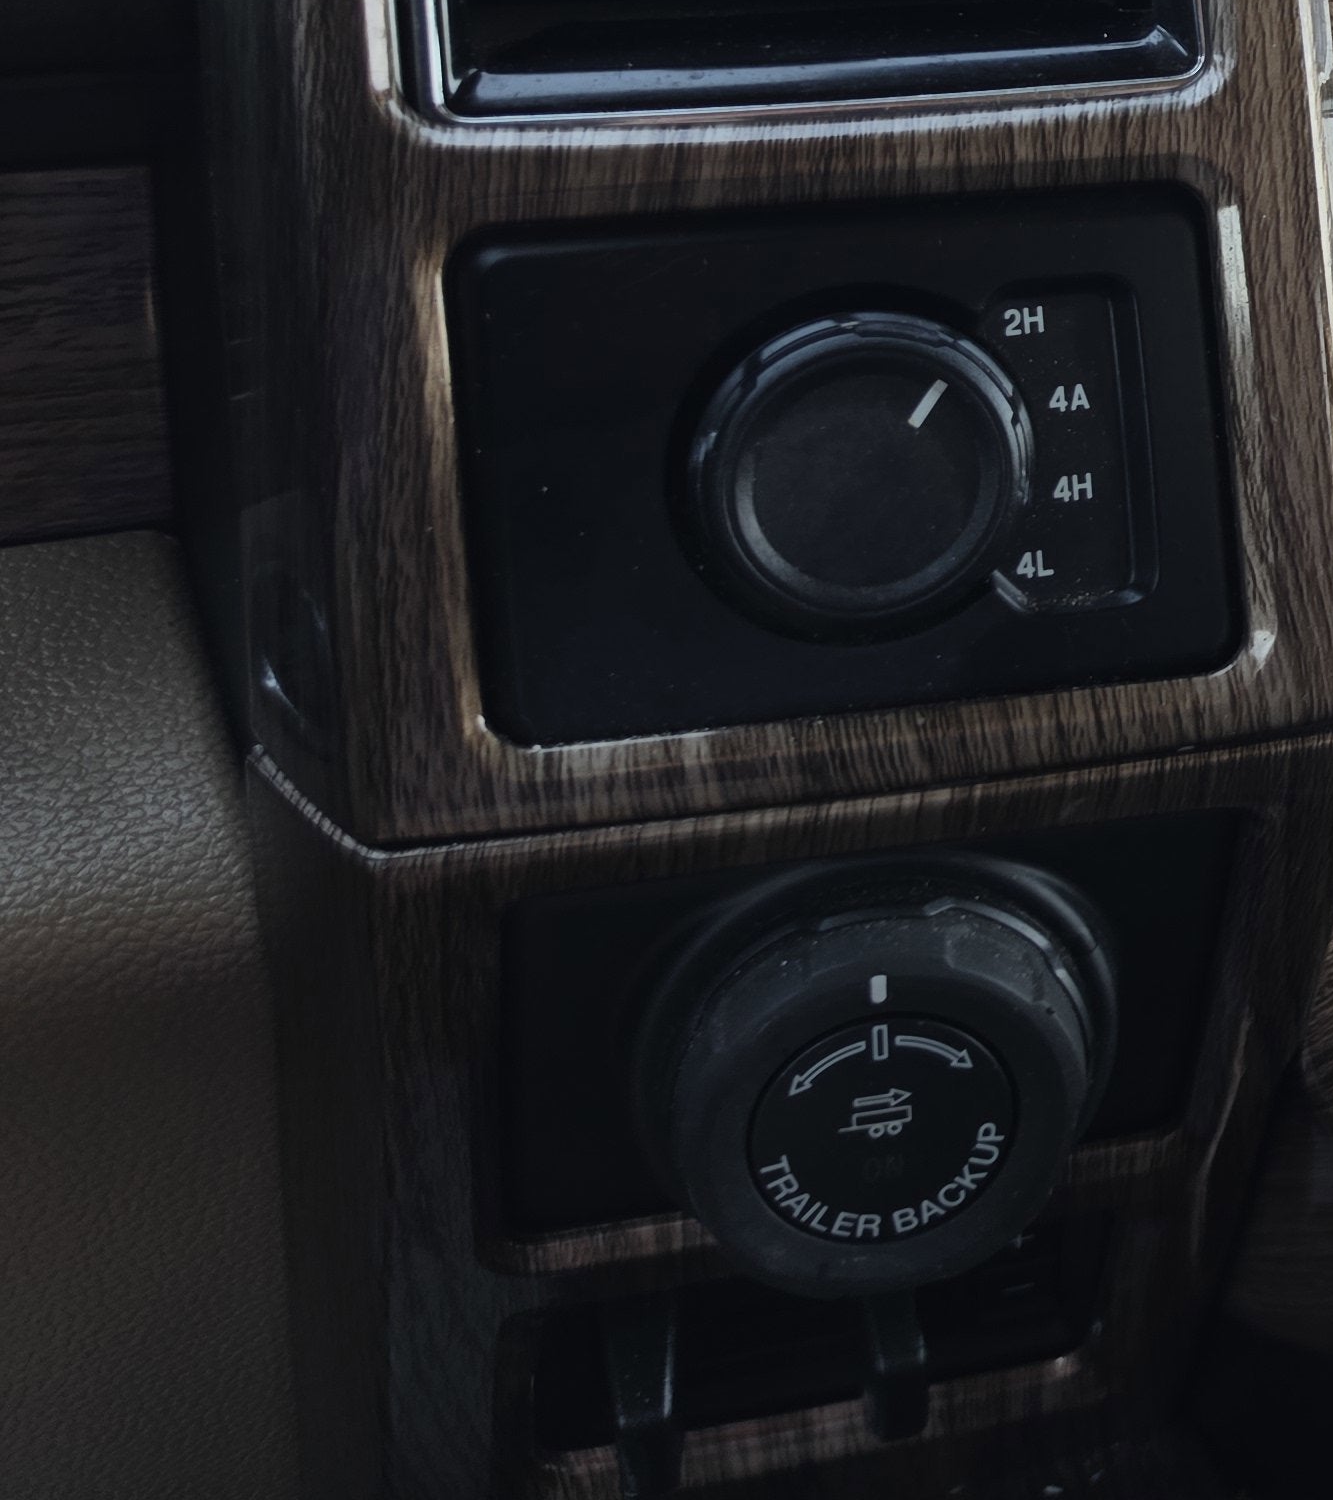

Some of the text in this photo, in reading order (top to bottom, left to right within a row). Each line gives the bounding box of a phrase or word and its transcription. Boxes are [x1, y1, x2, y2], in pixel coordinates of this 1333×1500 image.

[1003, 305, 1045, 337] 2H
[1048, 384, 1091, 411] 4A
[1052, 473, 1094, 503] 4H
[1015, 550, 1055, 579] 4L
[760, 1122, 1006, 1238] TRAILER BACKUP
